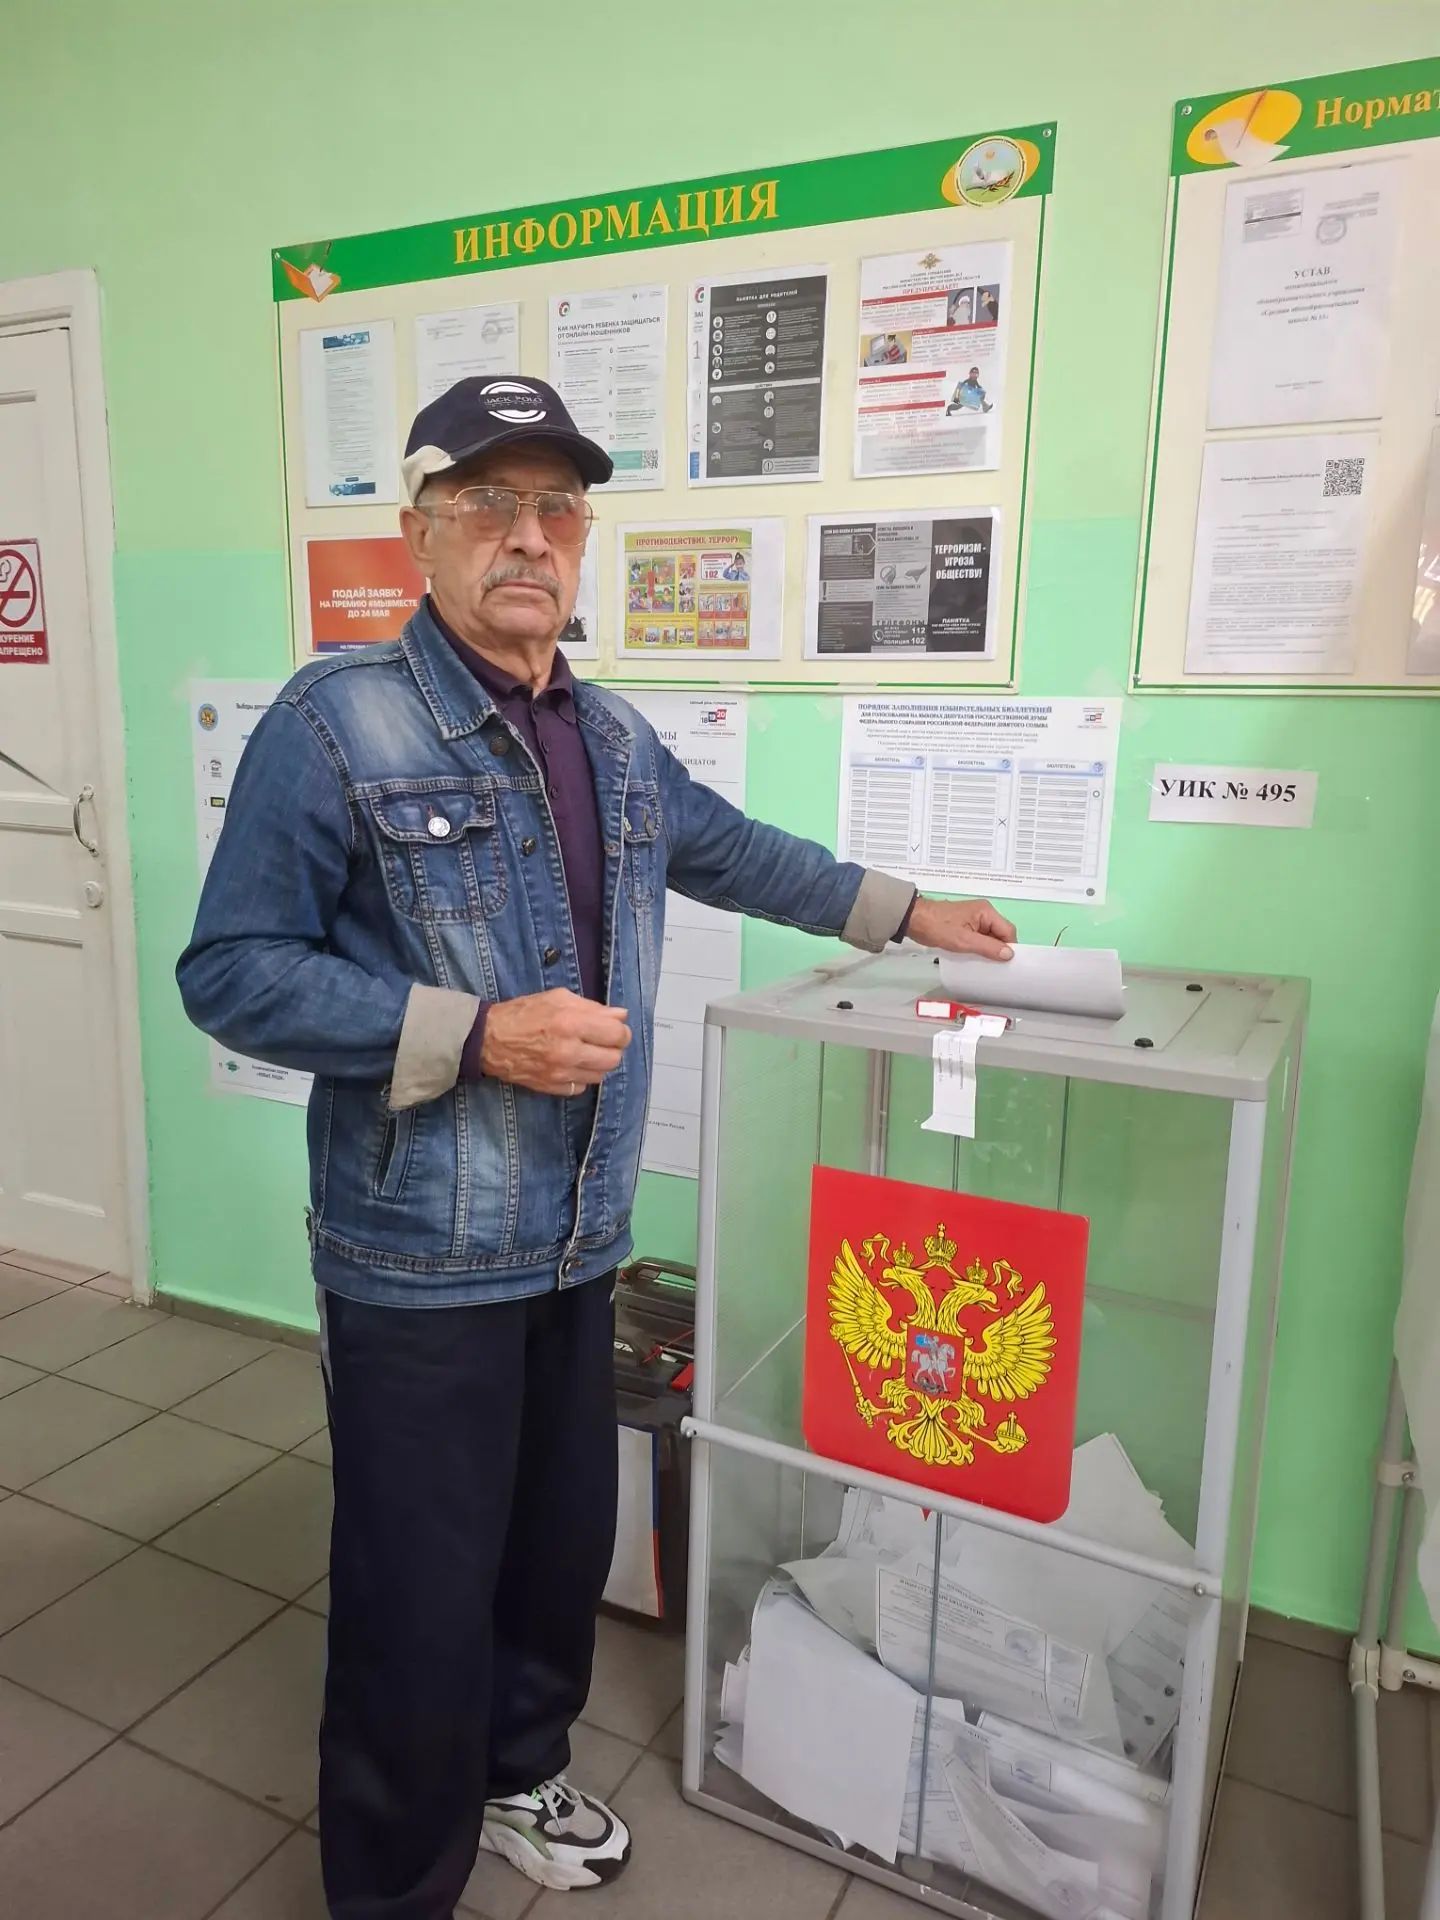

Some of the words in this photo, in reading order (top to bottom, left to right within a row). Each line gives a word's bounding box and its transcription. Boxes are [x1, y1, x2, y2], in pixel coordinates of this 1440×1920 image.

[454, 180, 780, 264] ИНФОРМАЦИЯ
[1294, 266, 1331, 279] УСТАВ
[569, 323, 595, 331] НАУЧИТЬ
[595, 321, 619, 329] РЕБЕНКА
[621, 316, 661, 326] ЗАЩИЩАТЬСЯ
[636, 536, 706, 547] ПРОТИВОДЕЙСТВИЕ
[708, 536, 739, 544] ТЕРРОРУ
[935, 543, 981, 555] ТЕРРОРИЗМ
[945, 556, 974, 567] УГРОЗА
[704, 570, 719, 579] 102
[936, 568, 983, 580] ОБЩЕСТВУ!
[332, 586, 366, 599] ПОДАЙ
[367, 588, 404, 598] ЗАЯВКУ
[319, 600, 331, 608] НА
[332, 600, 367, 608] ПРЕМИЮ
[347, 610, 360, 618] ДО
[360, 609, 370, 617] 24
[371, 609, 390, 617] МАЯ
[911, 637, 926, 645] 102
[1160, 779, 1216, 799] УИК
[1222, 782, 1249, 800] №
[1256, 783, 1297, 803] 495
